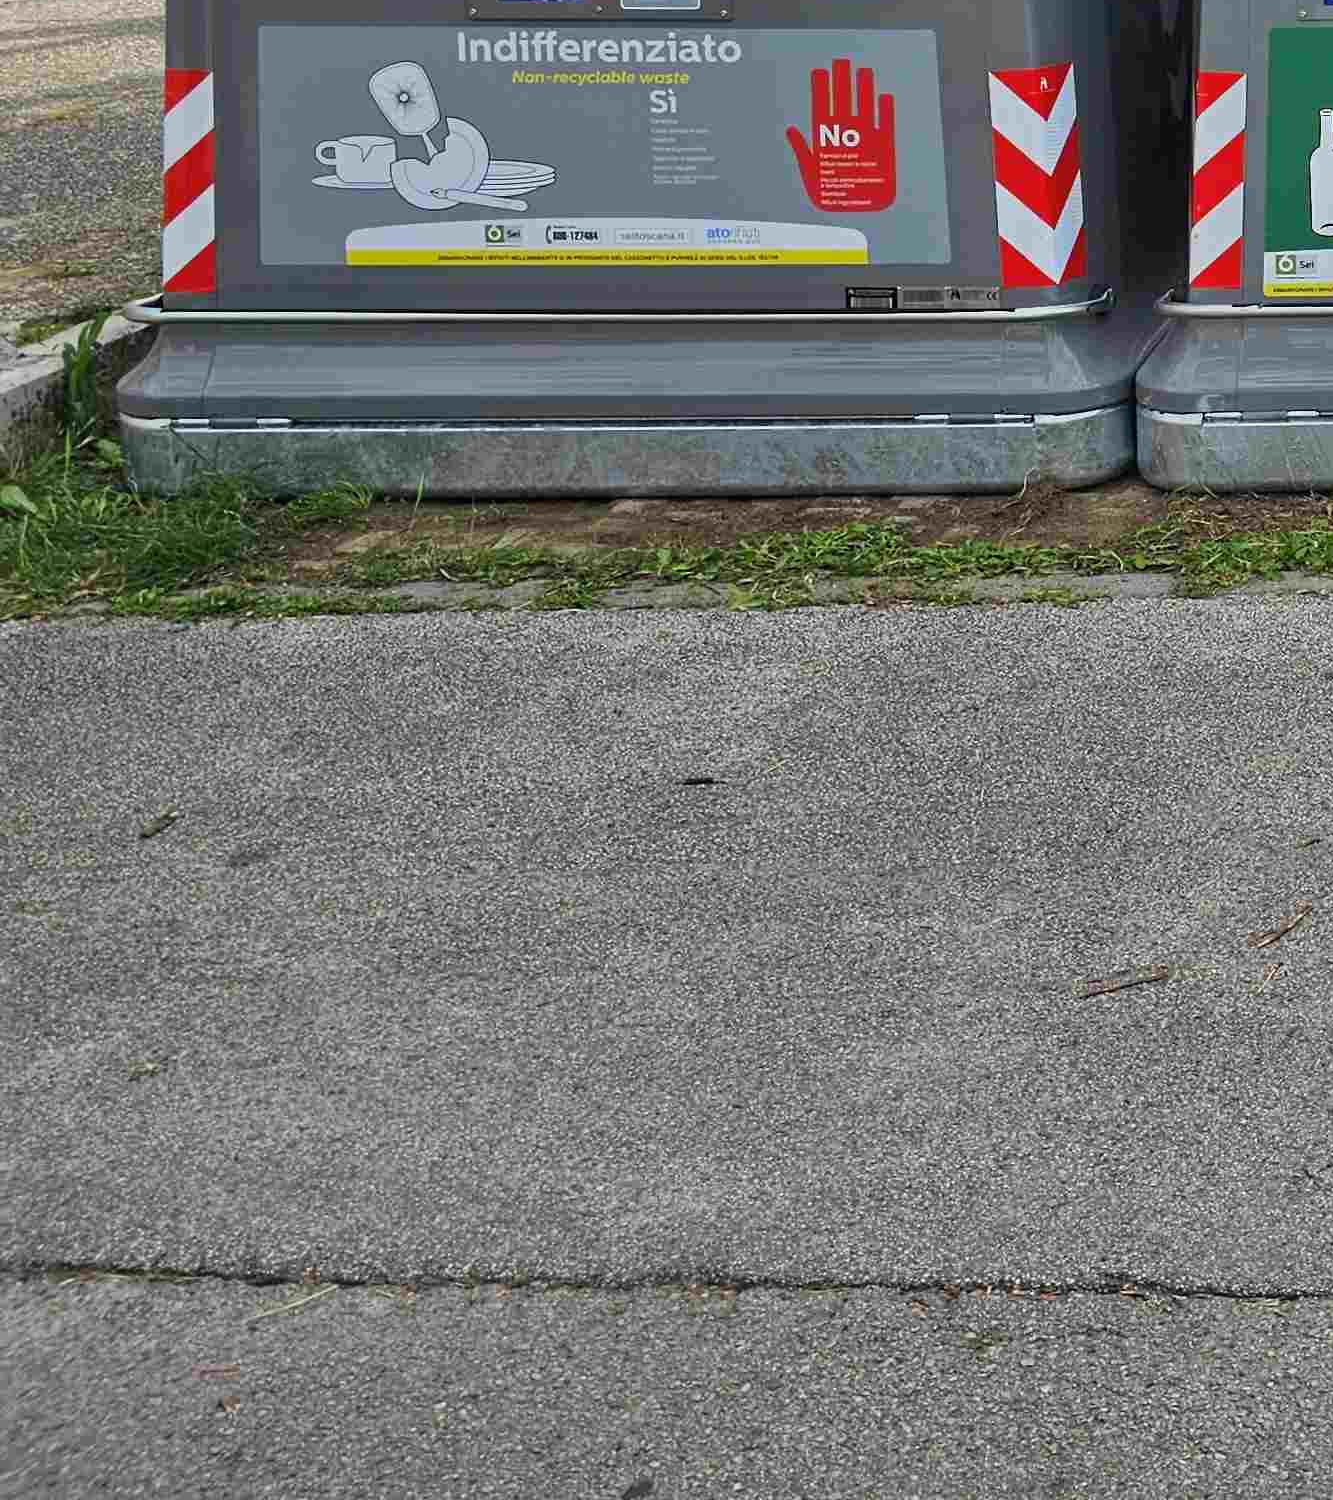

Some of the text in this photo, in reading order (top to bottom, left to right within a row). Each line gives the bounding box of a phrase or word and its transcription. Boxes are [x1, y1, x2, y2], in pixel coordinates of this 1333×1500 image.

[457, 31, 742, 63] Indifferenziato
[511, 71, 689, 87] Non-recyclable waste
[650, 88, 677, 113] Sì
[819, 124, 860, 147] No
